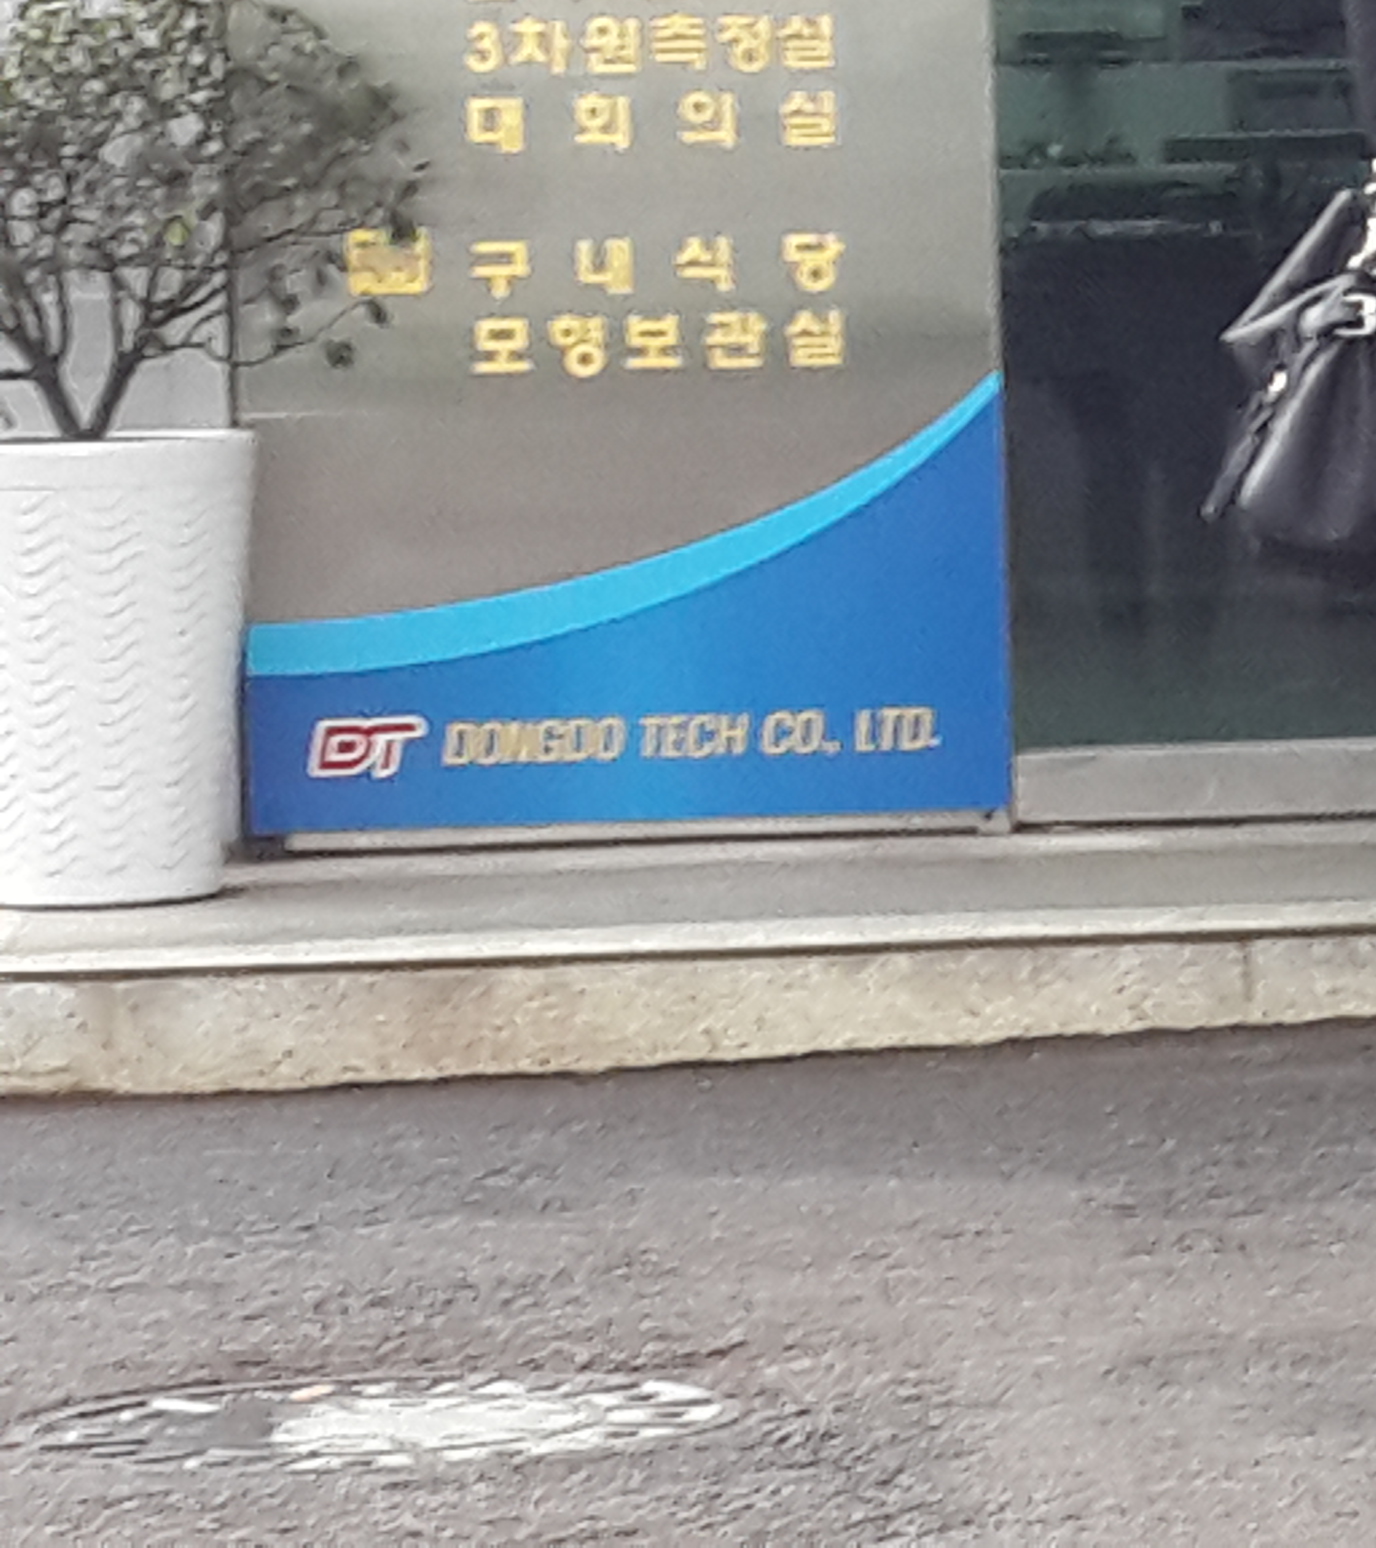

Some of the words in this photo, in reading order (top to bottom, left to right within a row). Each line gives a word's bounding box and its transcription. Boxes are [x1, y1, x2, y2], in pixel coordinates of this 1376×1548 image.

[463, 13, 837, 75] 3차원측정실
[442, 716, 625, 767] DONGDO
[638, 712, 750, 758] TECH
